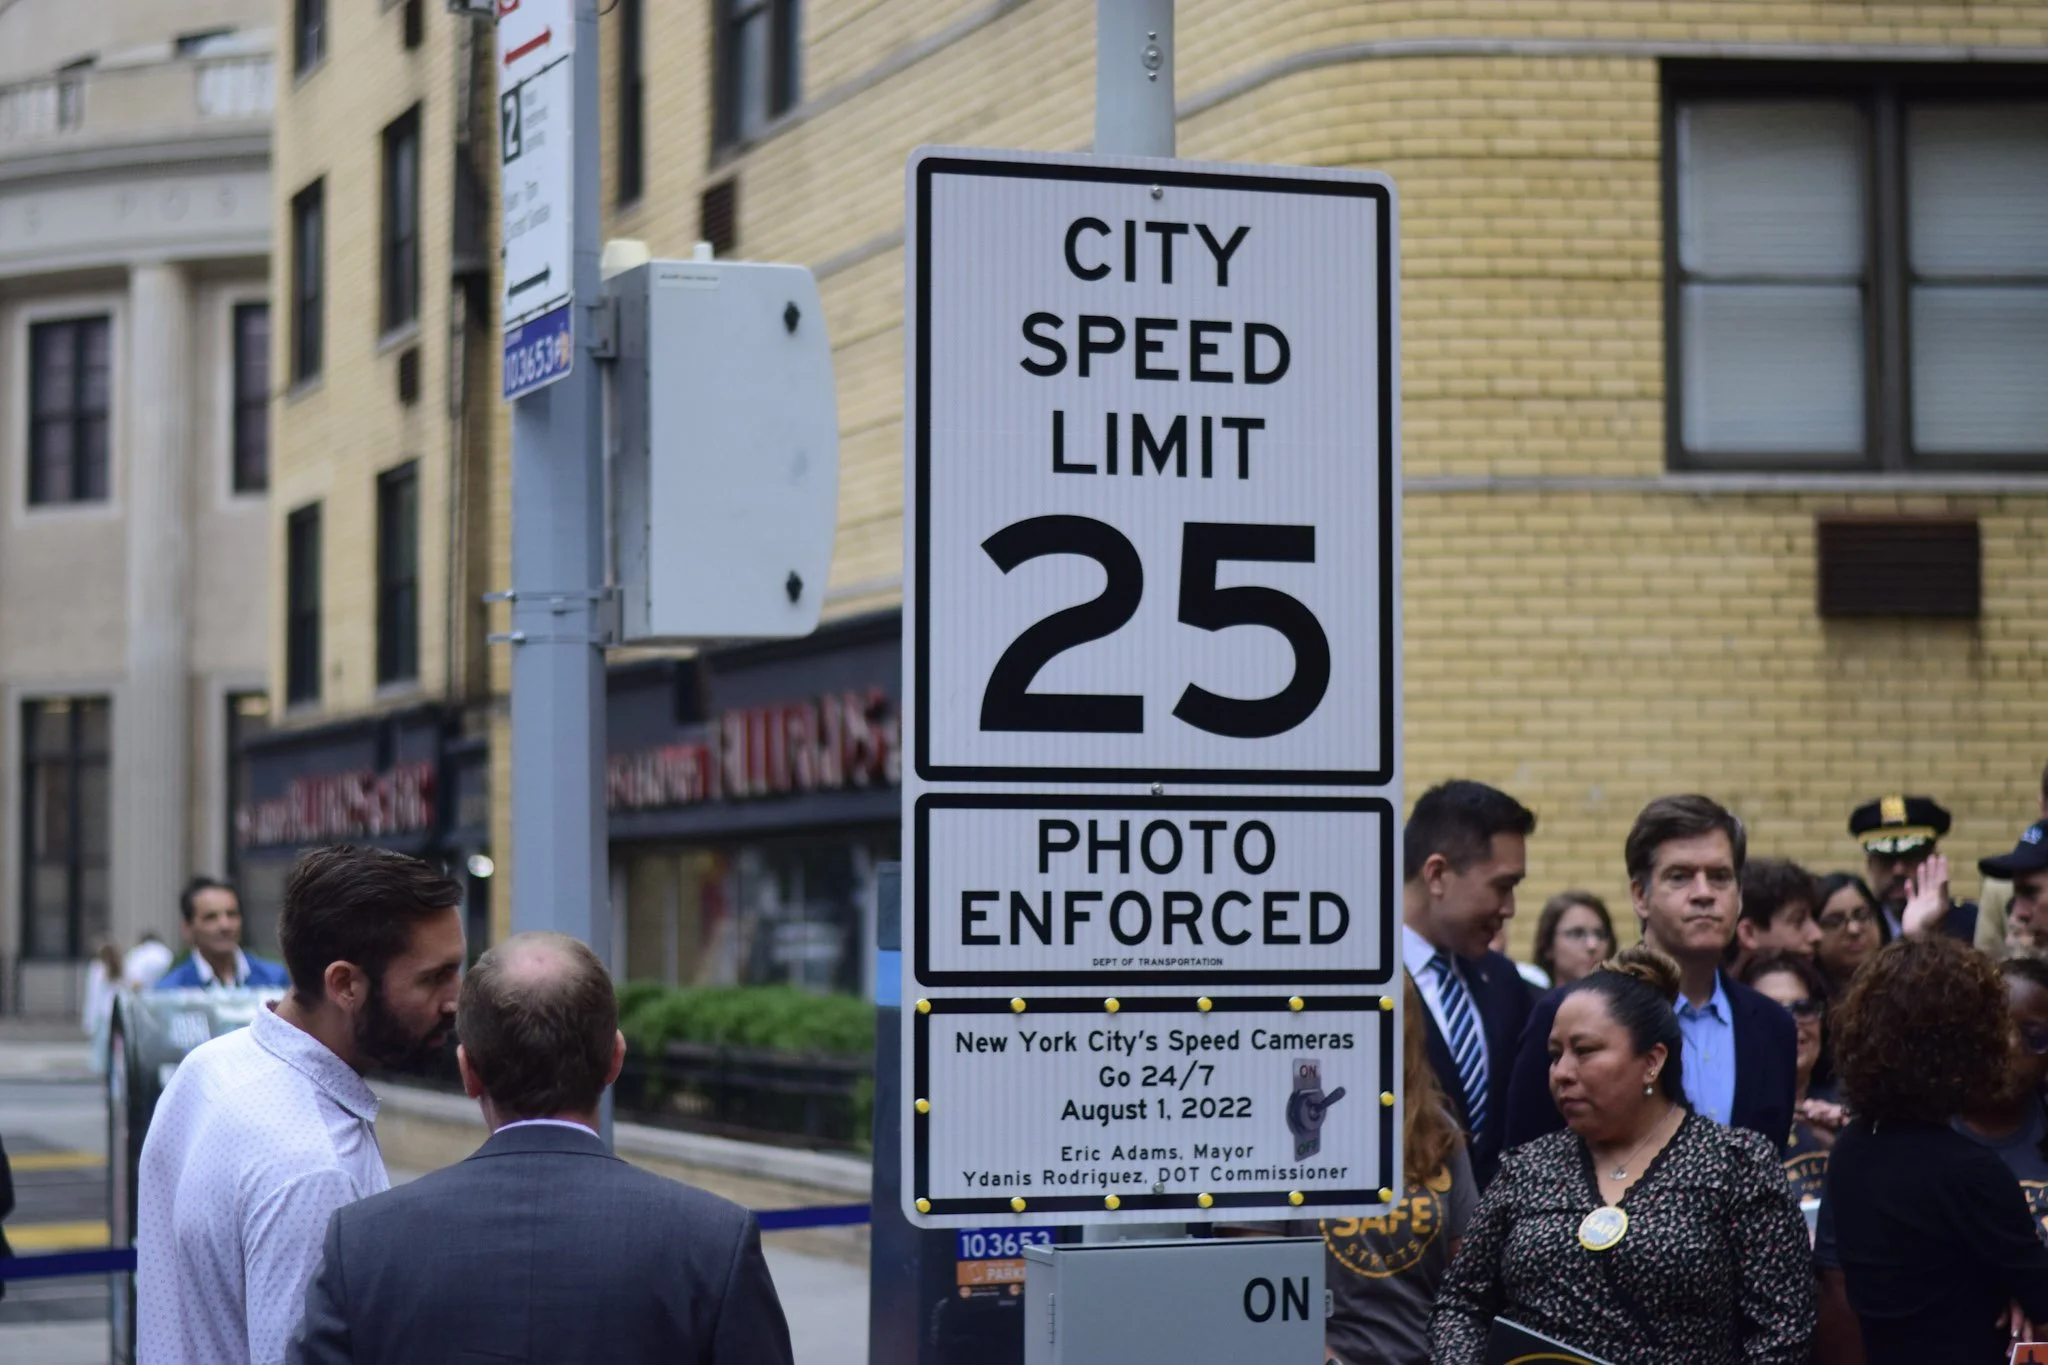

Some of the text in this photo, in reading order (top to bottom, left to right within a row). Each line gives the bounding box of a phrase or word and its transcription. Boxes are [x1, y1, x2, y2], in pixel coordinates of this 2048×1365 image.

[1065, 216, 1250, 287] CITY
[1020, 311, 1290, 385] SPEED
[1053, 410, 1266, 480] LIMIT
[980, 514, 1331, 739] 25
[1039, 819, 1275, 875] PHOTO
[962, 891, 1349, 946] ENFORCED
[1093, 957, 1223, 966] DEPT OF TRANSPORTATION
[957, 1028, 1354, 1057] New York City's Speed Cameras
[1099, 1059, 1215, 1091] Go 24/7
[1300, 1064, 1317, 1078] ON
[1061, 1099, 1147, 1128] August
[1182, 1096, 1252, 1119] 2022
[1061, 1145, 1101, 1162] Eric
[1193, 1143, 1254, 1162] Mayor
[963, 1170, 1031, 1187] Ydanis
[1158, 1166, 1200, 1184] DOT
[1210, 1165, 1347, 1182] Commissioner
[987, 1267, 1024, 1281] PARK
[1244, 1276, 1310, 1322] ON
